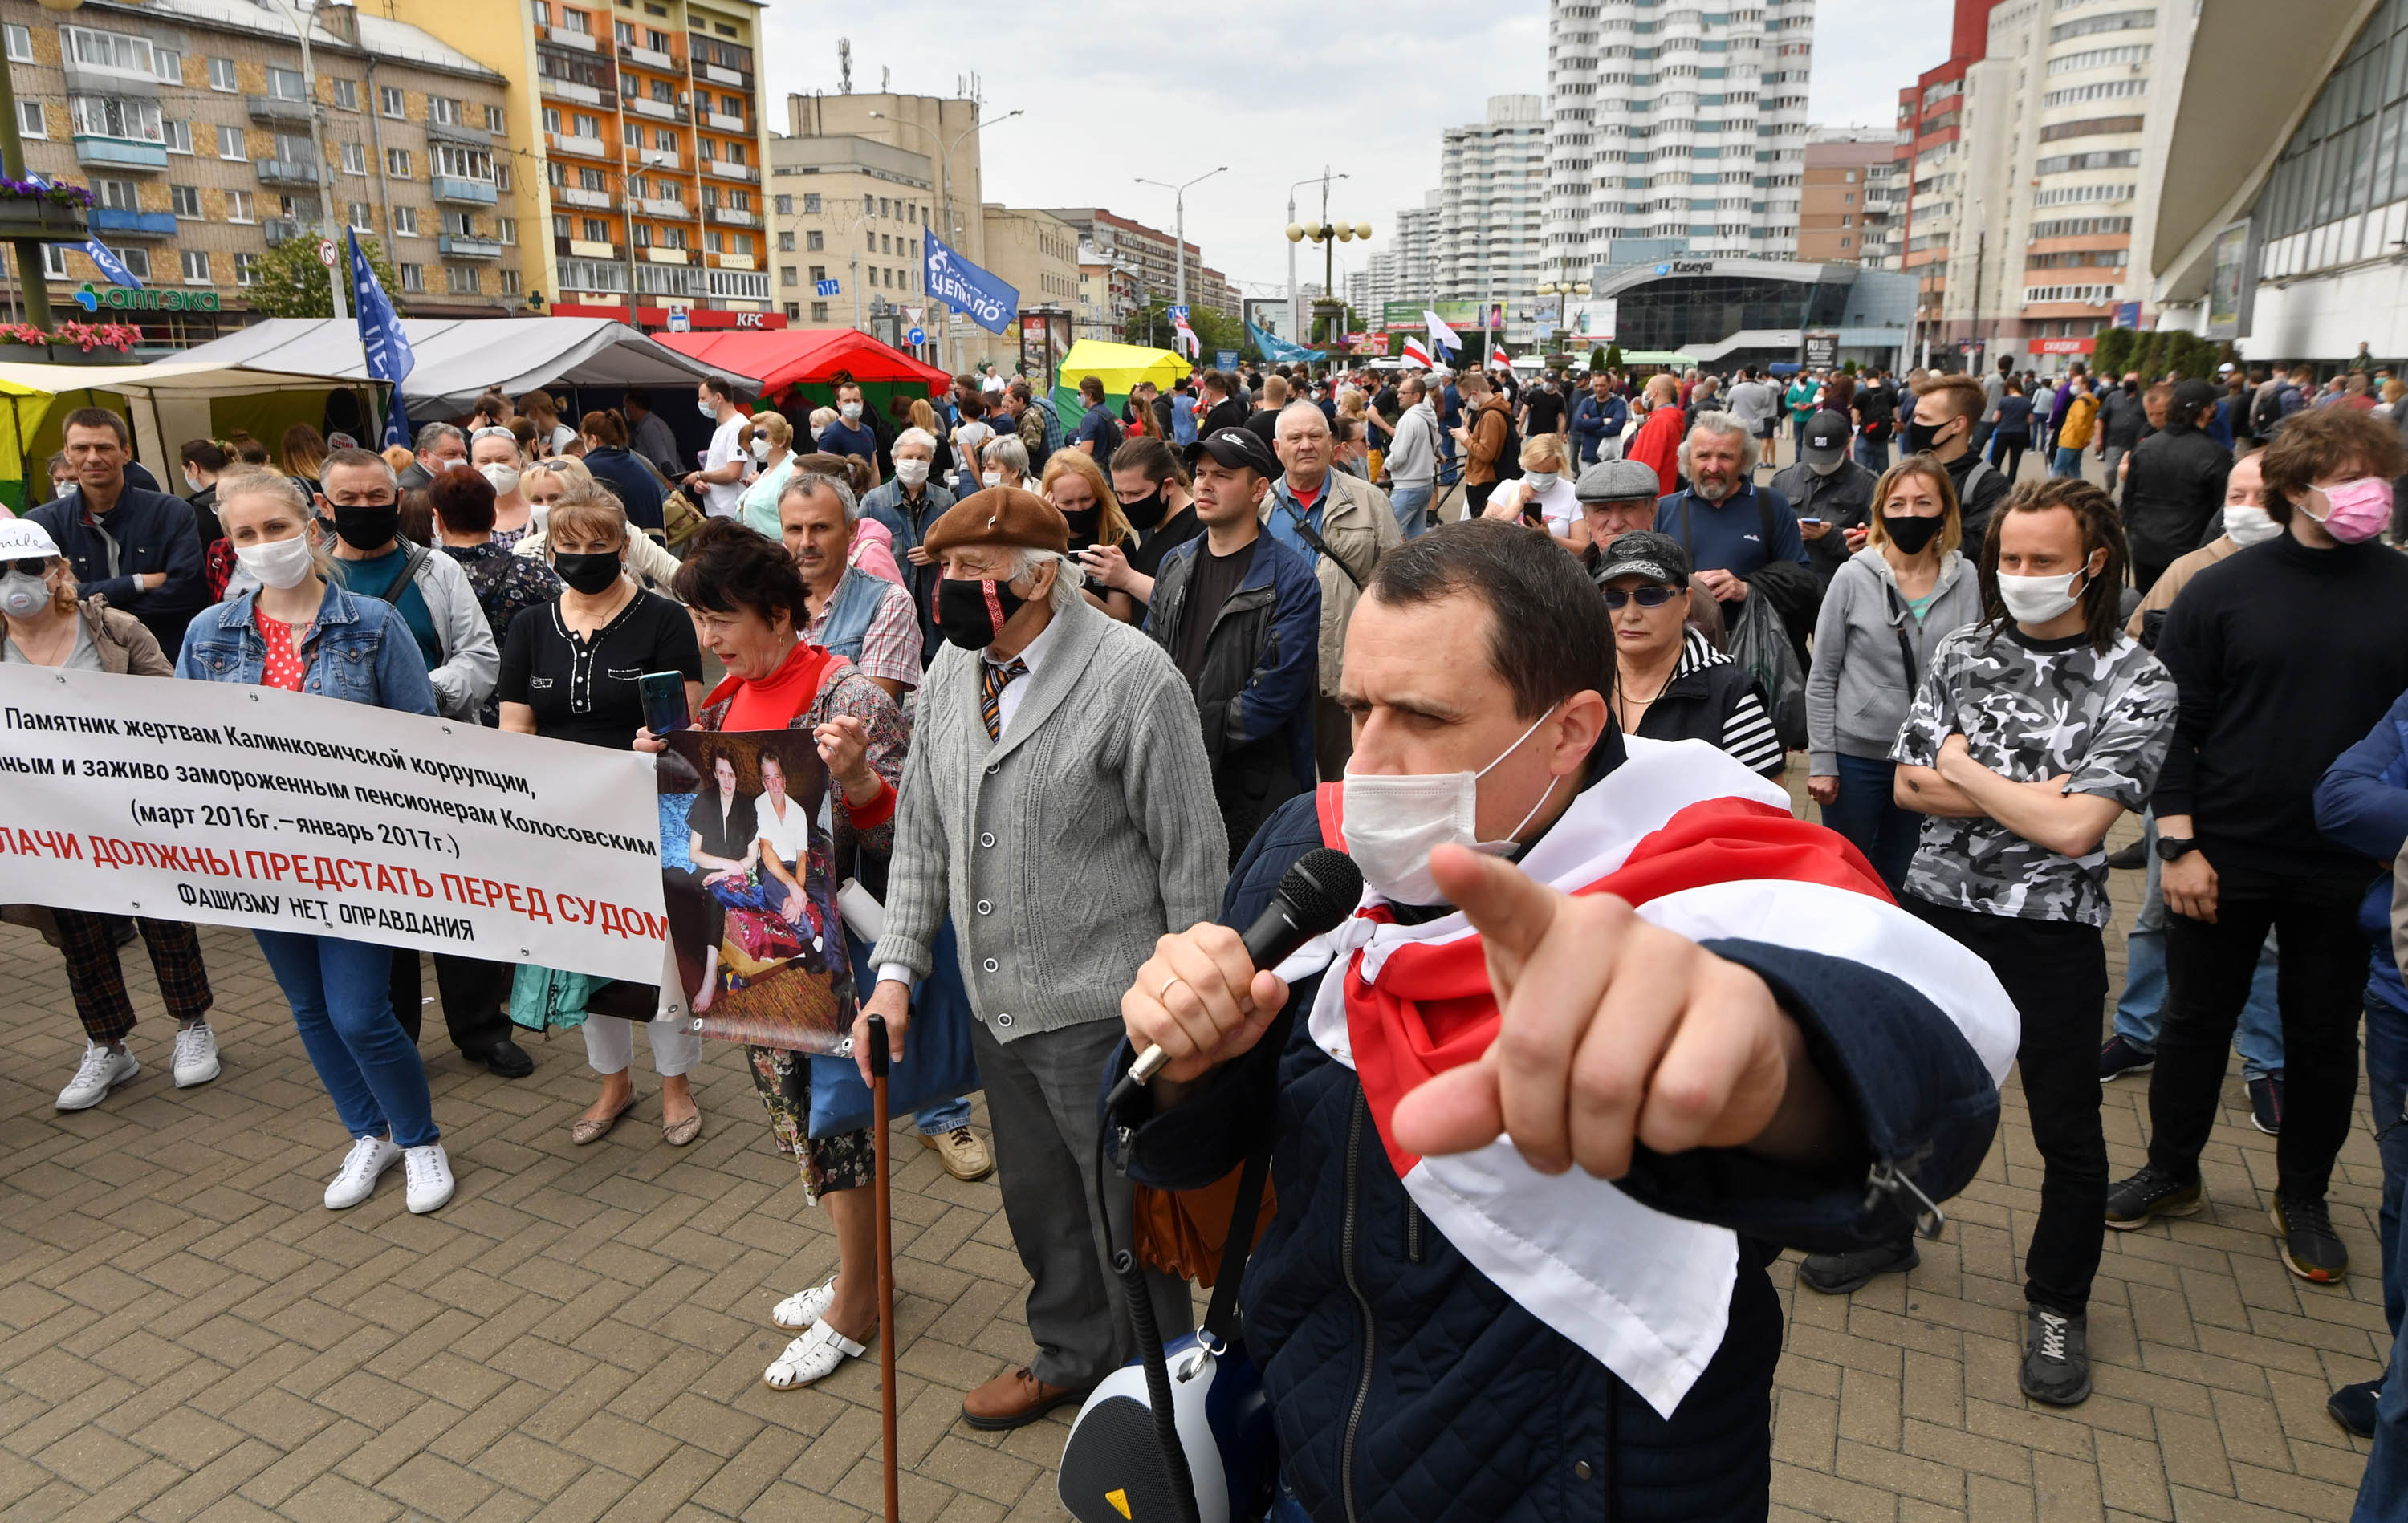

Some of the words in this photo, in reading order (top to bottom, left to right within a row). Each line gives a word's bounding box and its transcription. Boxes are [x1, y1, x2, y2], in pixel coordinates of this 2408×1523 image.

[1673, 261, 1713, 274] Kaseya
[106, 288, 221, 311] аптэка
[736, 312, 763, 327] KFC
[5, 707, 120, 736] Памятник
[122, 719, 222, 745] жертвам
[223, 725, 407, 772] Калинковичской
[409, 756, 536, 800] коррупции,
[62, 759, 76, 776] и
[83, 760, 169, 782] заживо
[175, 766, 349, 800] замороженным
[354, 782, 498, 826] пенсионерам
[499, 808, 657, 856] Колосовским
[131, 798, 195, 829] (март
[377, 823, 461, 859] 2017г.)
[89, 835, 242, 878] ДОЛЖНЫ
[245, 851, 434, 898] ПРЕДСТАТЬ
[440, 872, 553, 925] ПЕРЕД
[556, 893, 669, 941] СУДОМ
[177, 883, 279, 915] ФАШИЗМУ
[289, 897, 329, 920] НЕТ
[339, 904, 474, 941] ОПРАВДАНИЯ
